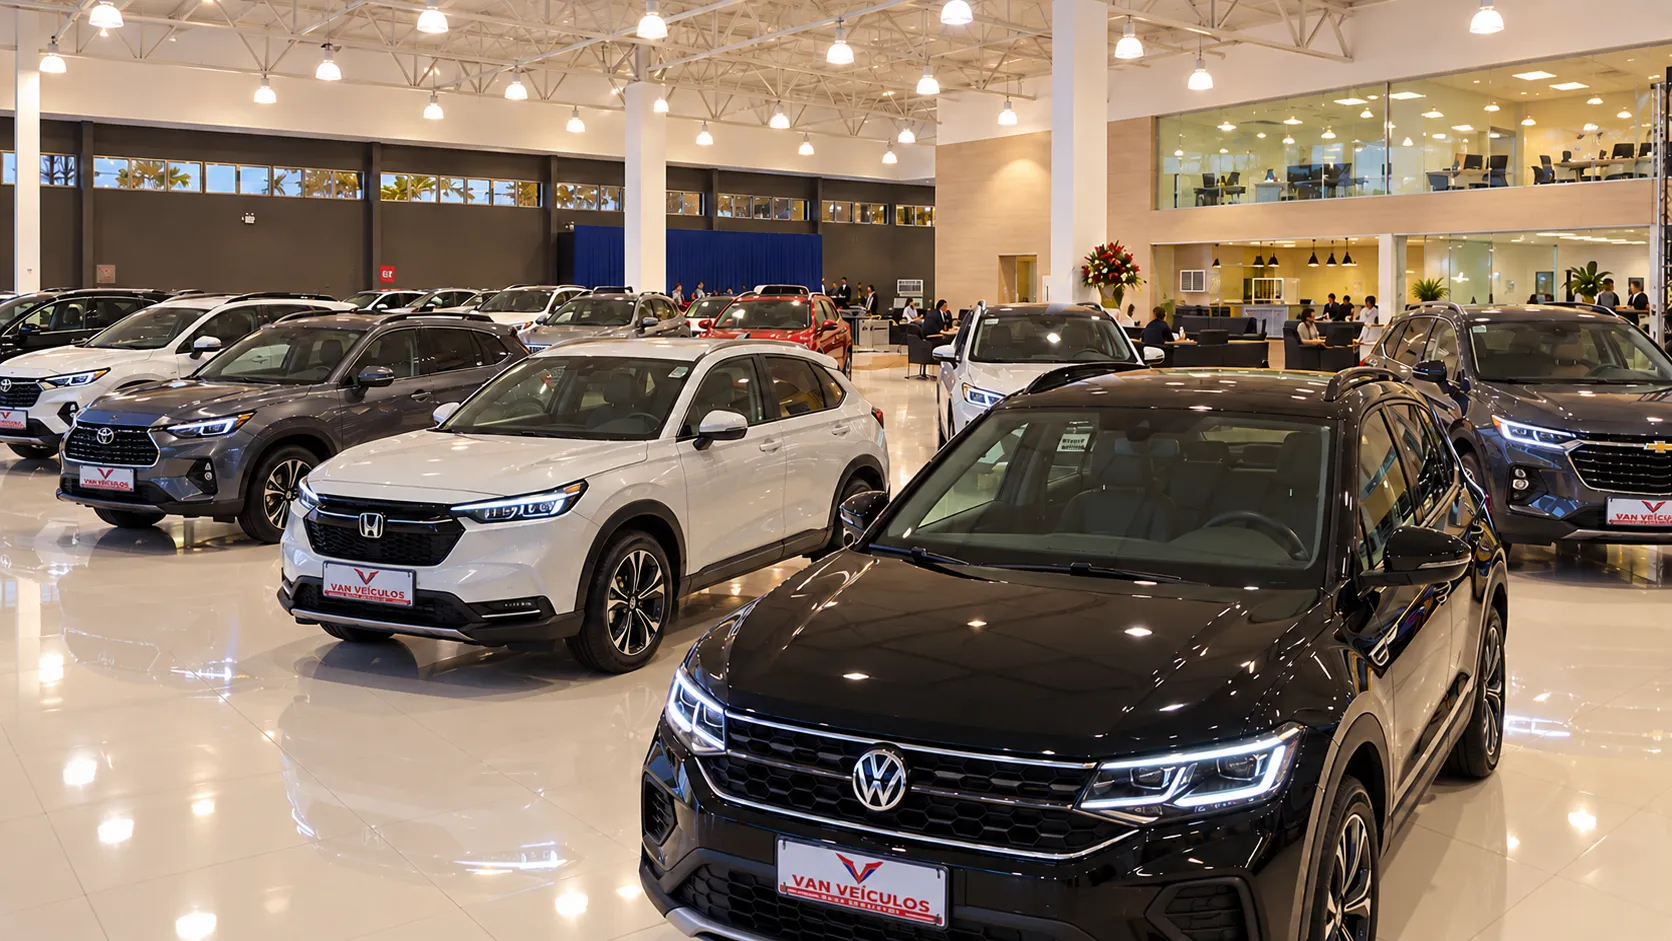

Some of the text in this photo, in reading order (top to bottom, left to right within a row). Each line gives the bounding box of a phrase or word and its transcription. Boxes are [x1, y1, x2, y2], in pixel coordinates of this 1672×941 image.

[330, 583, 352, 592] VAN
[354, 585, 405, 599] VEÍCULOS
[791, 874, 831, 893] VAN
[836, 884, 931, 913] VEÍCULOS
